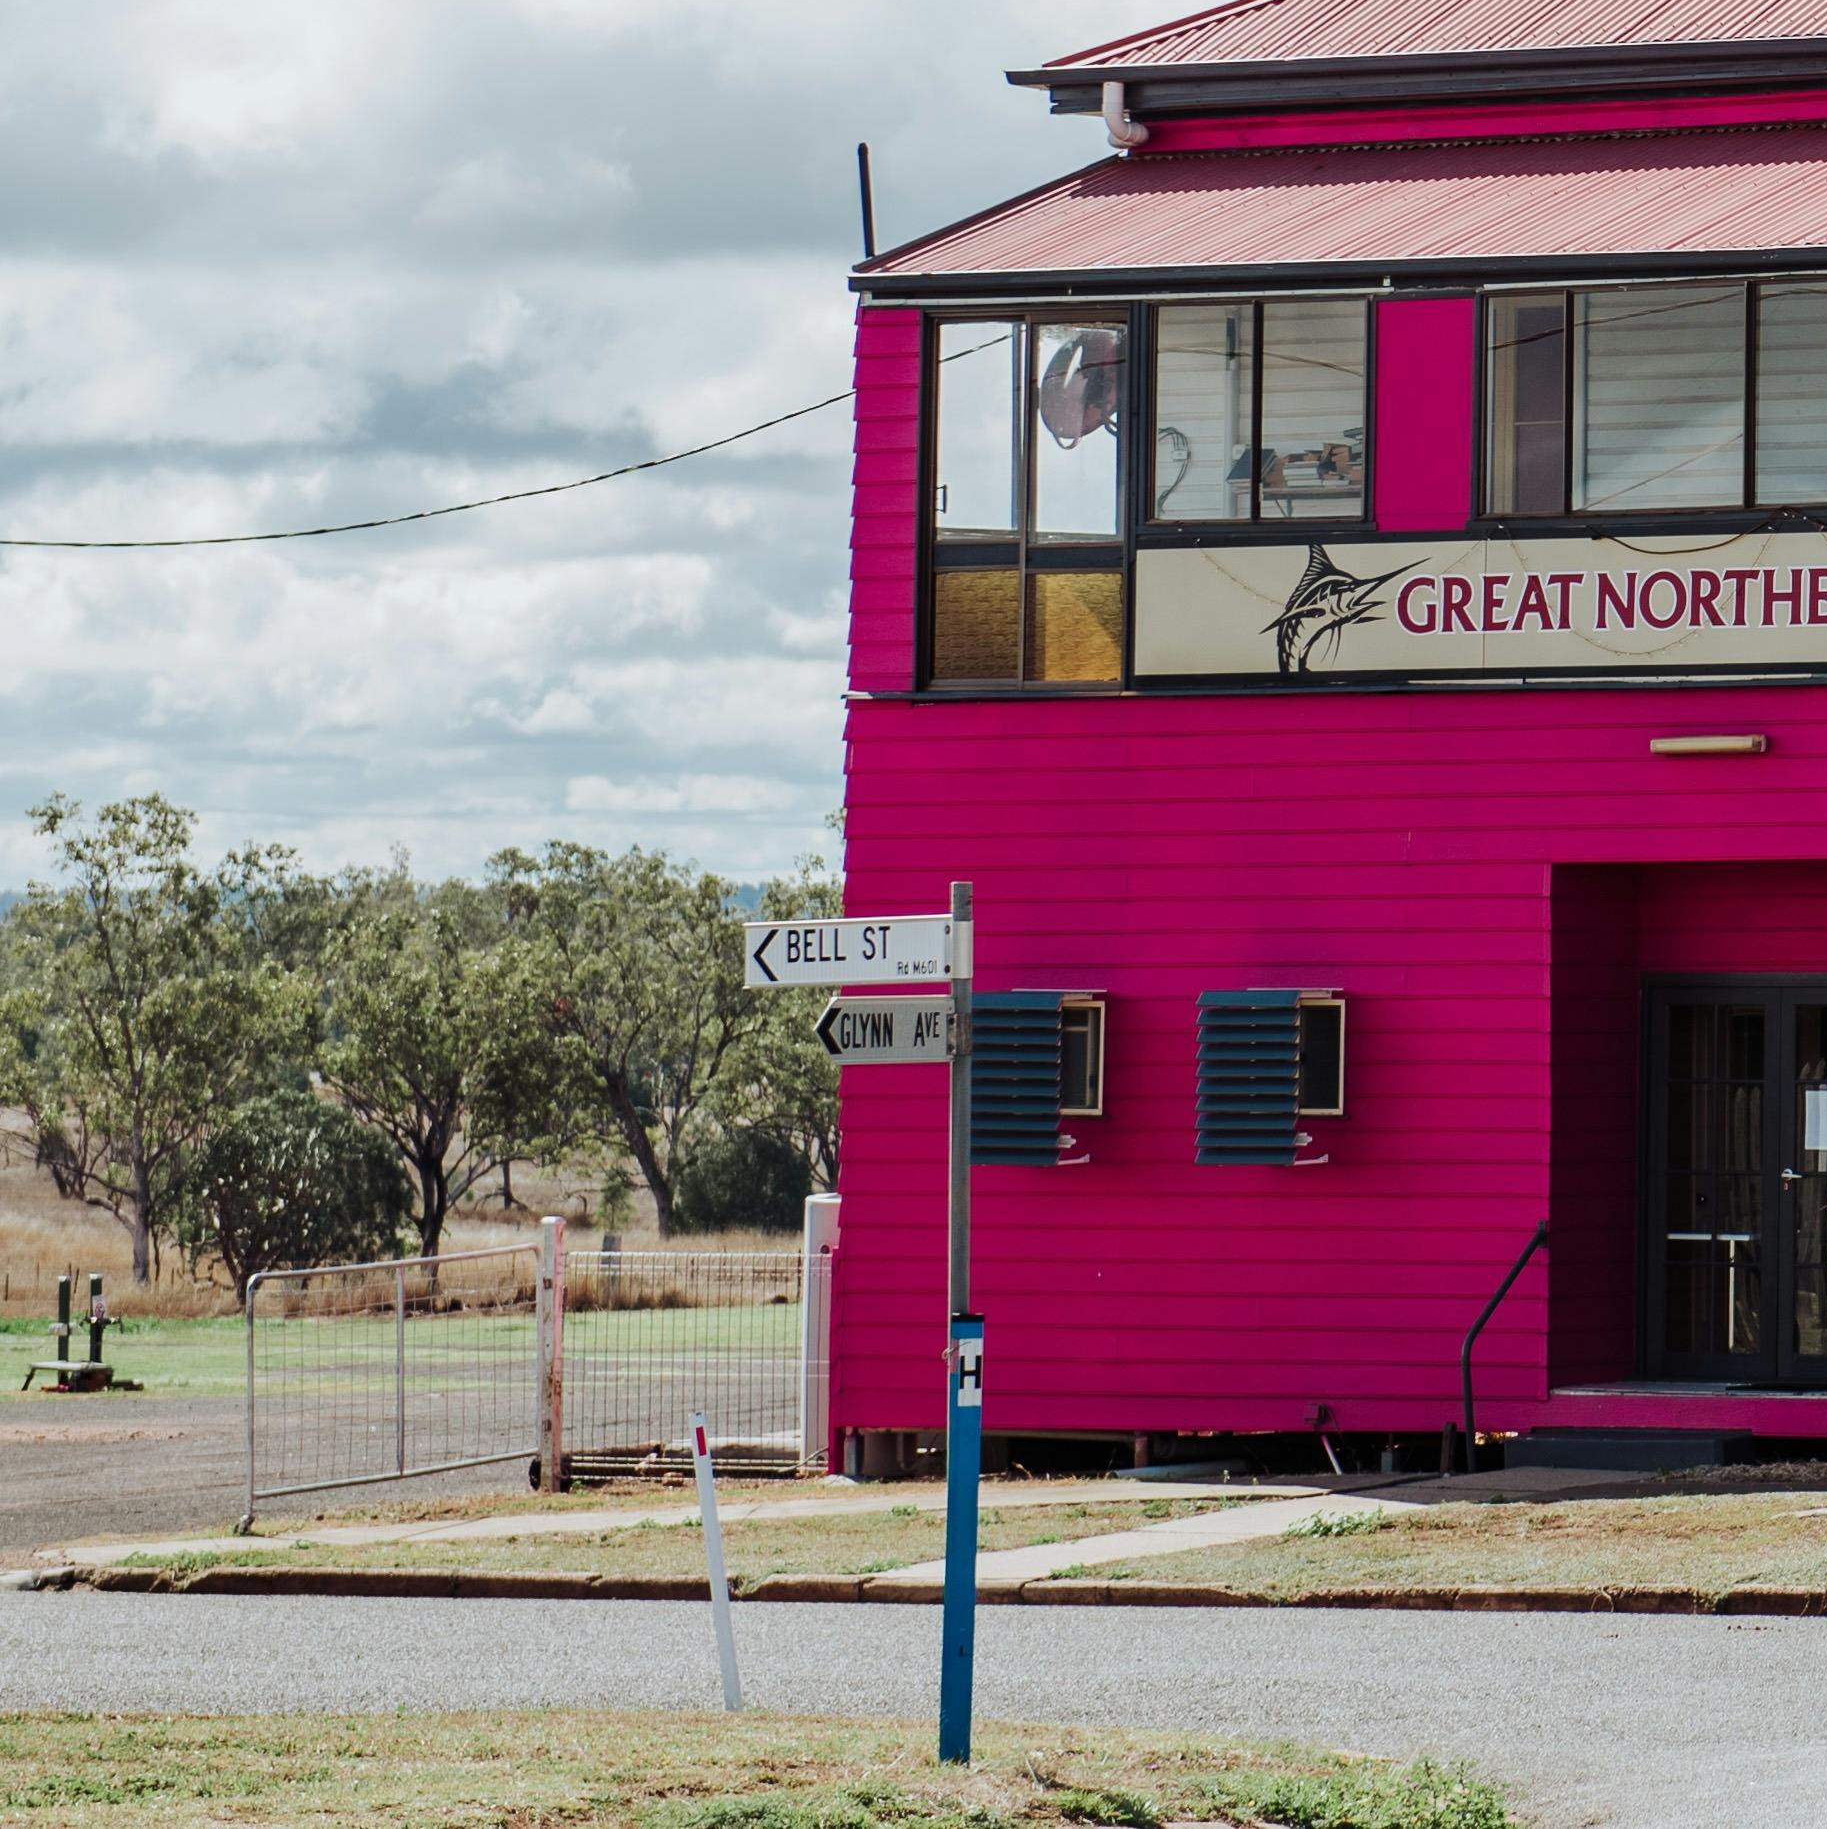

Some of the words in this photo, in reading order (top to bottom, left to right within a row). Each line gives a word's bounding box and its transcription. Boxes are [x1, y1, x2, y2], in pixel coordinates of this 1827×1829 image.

[1398, 572, 1584, 636] GREAT
[787, 928, 847, 963] BELL
[863, 926, 891, 960] ST
[897, 961, 909, 975] Rd
[913, 960, 938, 975] M601
[840, 1012, 893, 1050] GLYNN
[914, 1011, 940, 1047] AVE
[960, 1355, 982, 1390] H
